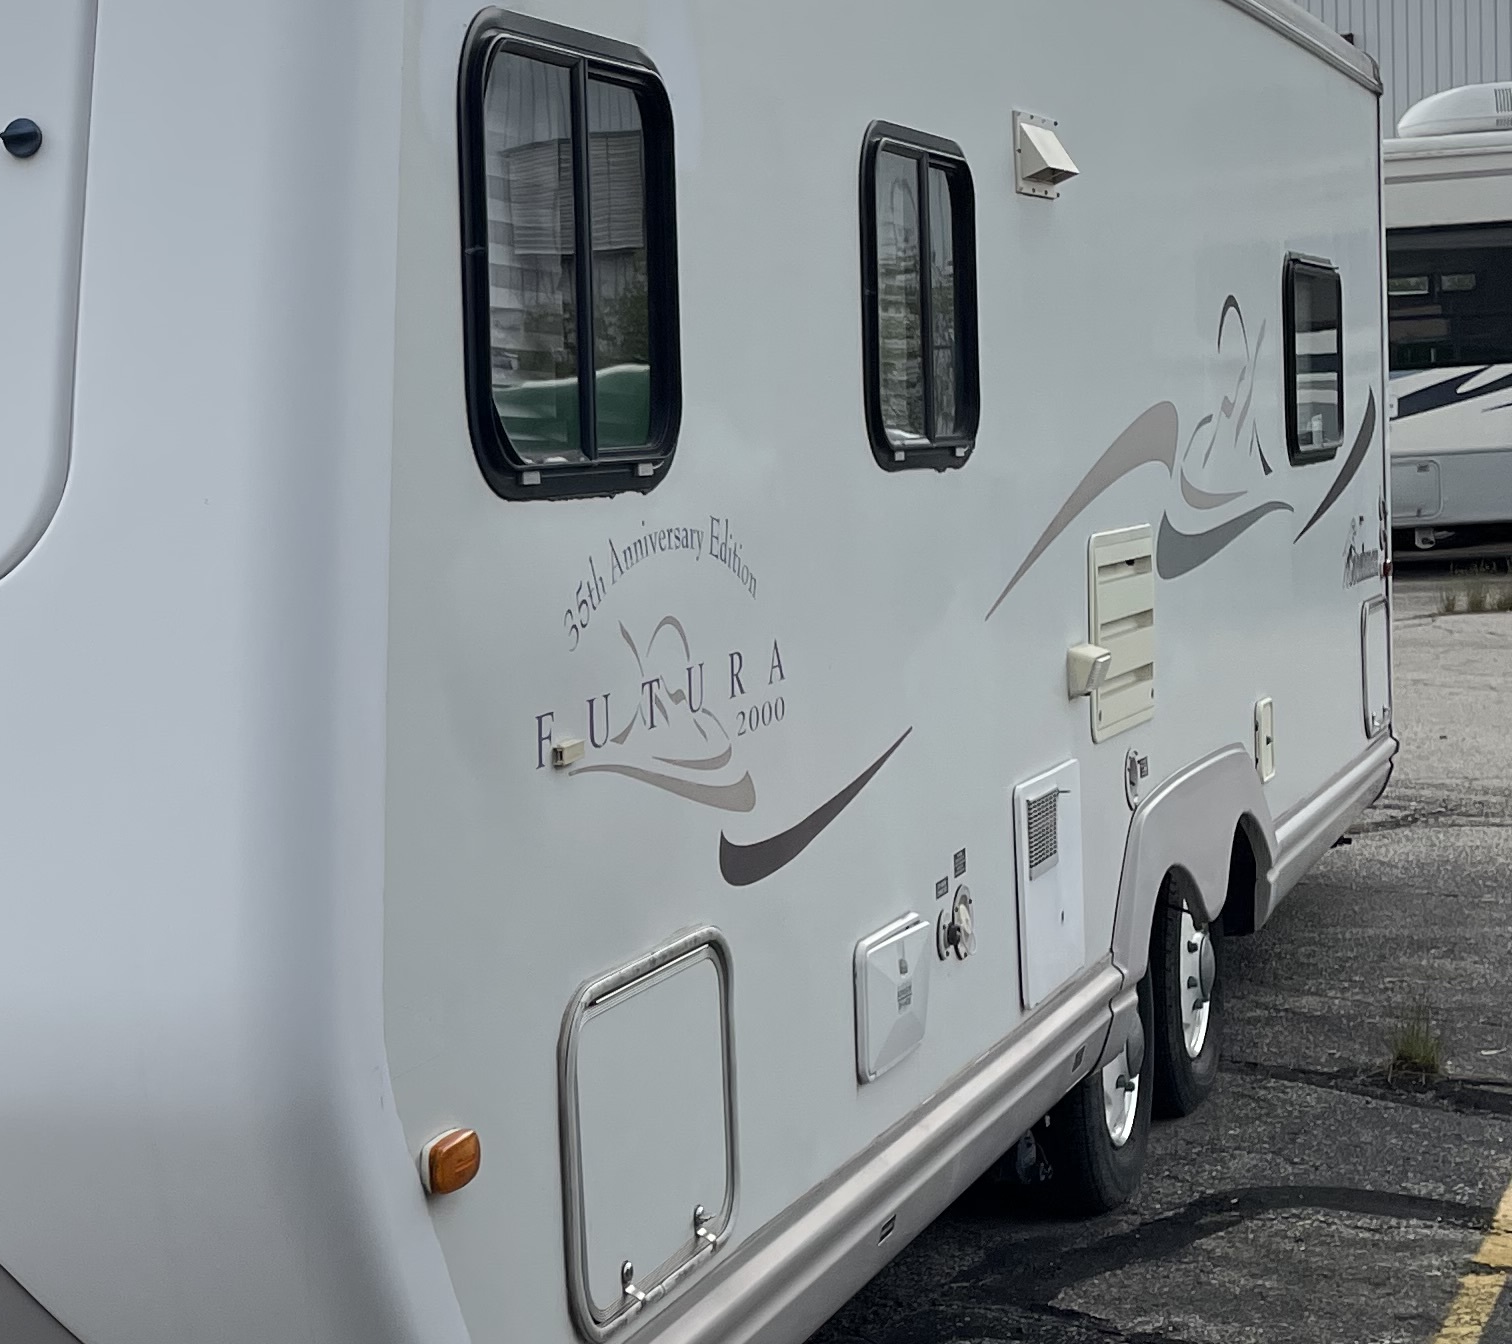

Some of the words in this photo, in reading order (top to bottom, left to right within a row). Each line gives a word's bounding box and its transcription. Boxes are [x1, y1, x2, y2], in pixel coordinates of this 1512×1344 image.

[563, 555, 607, 652] 35th
[608, 520, 705, 585] Anniversary
[709, 515, 758, 601] Edition
[535, 638, 787, 770] FUTURA
[735, 696, 786, 737] 2000
